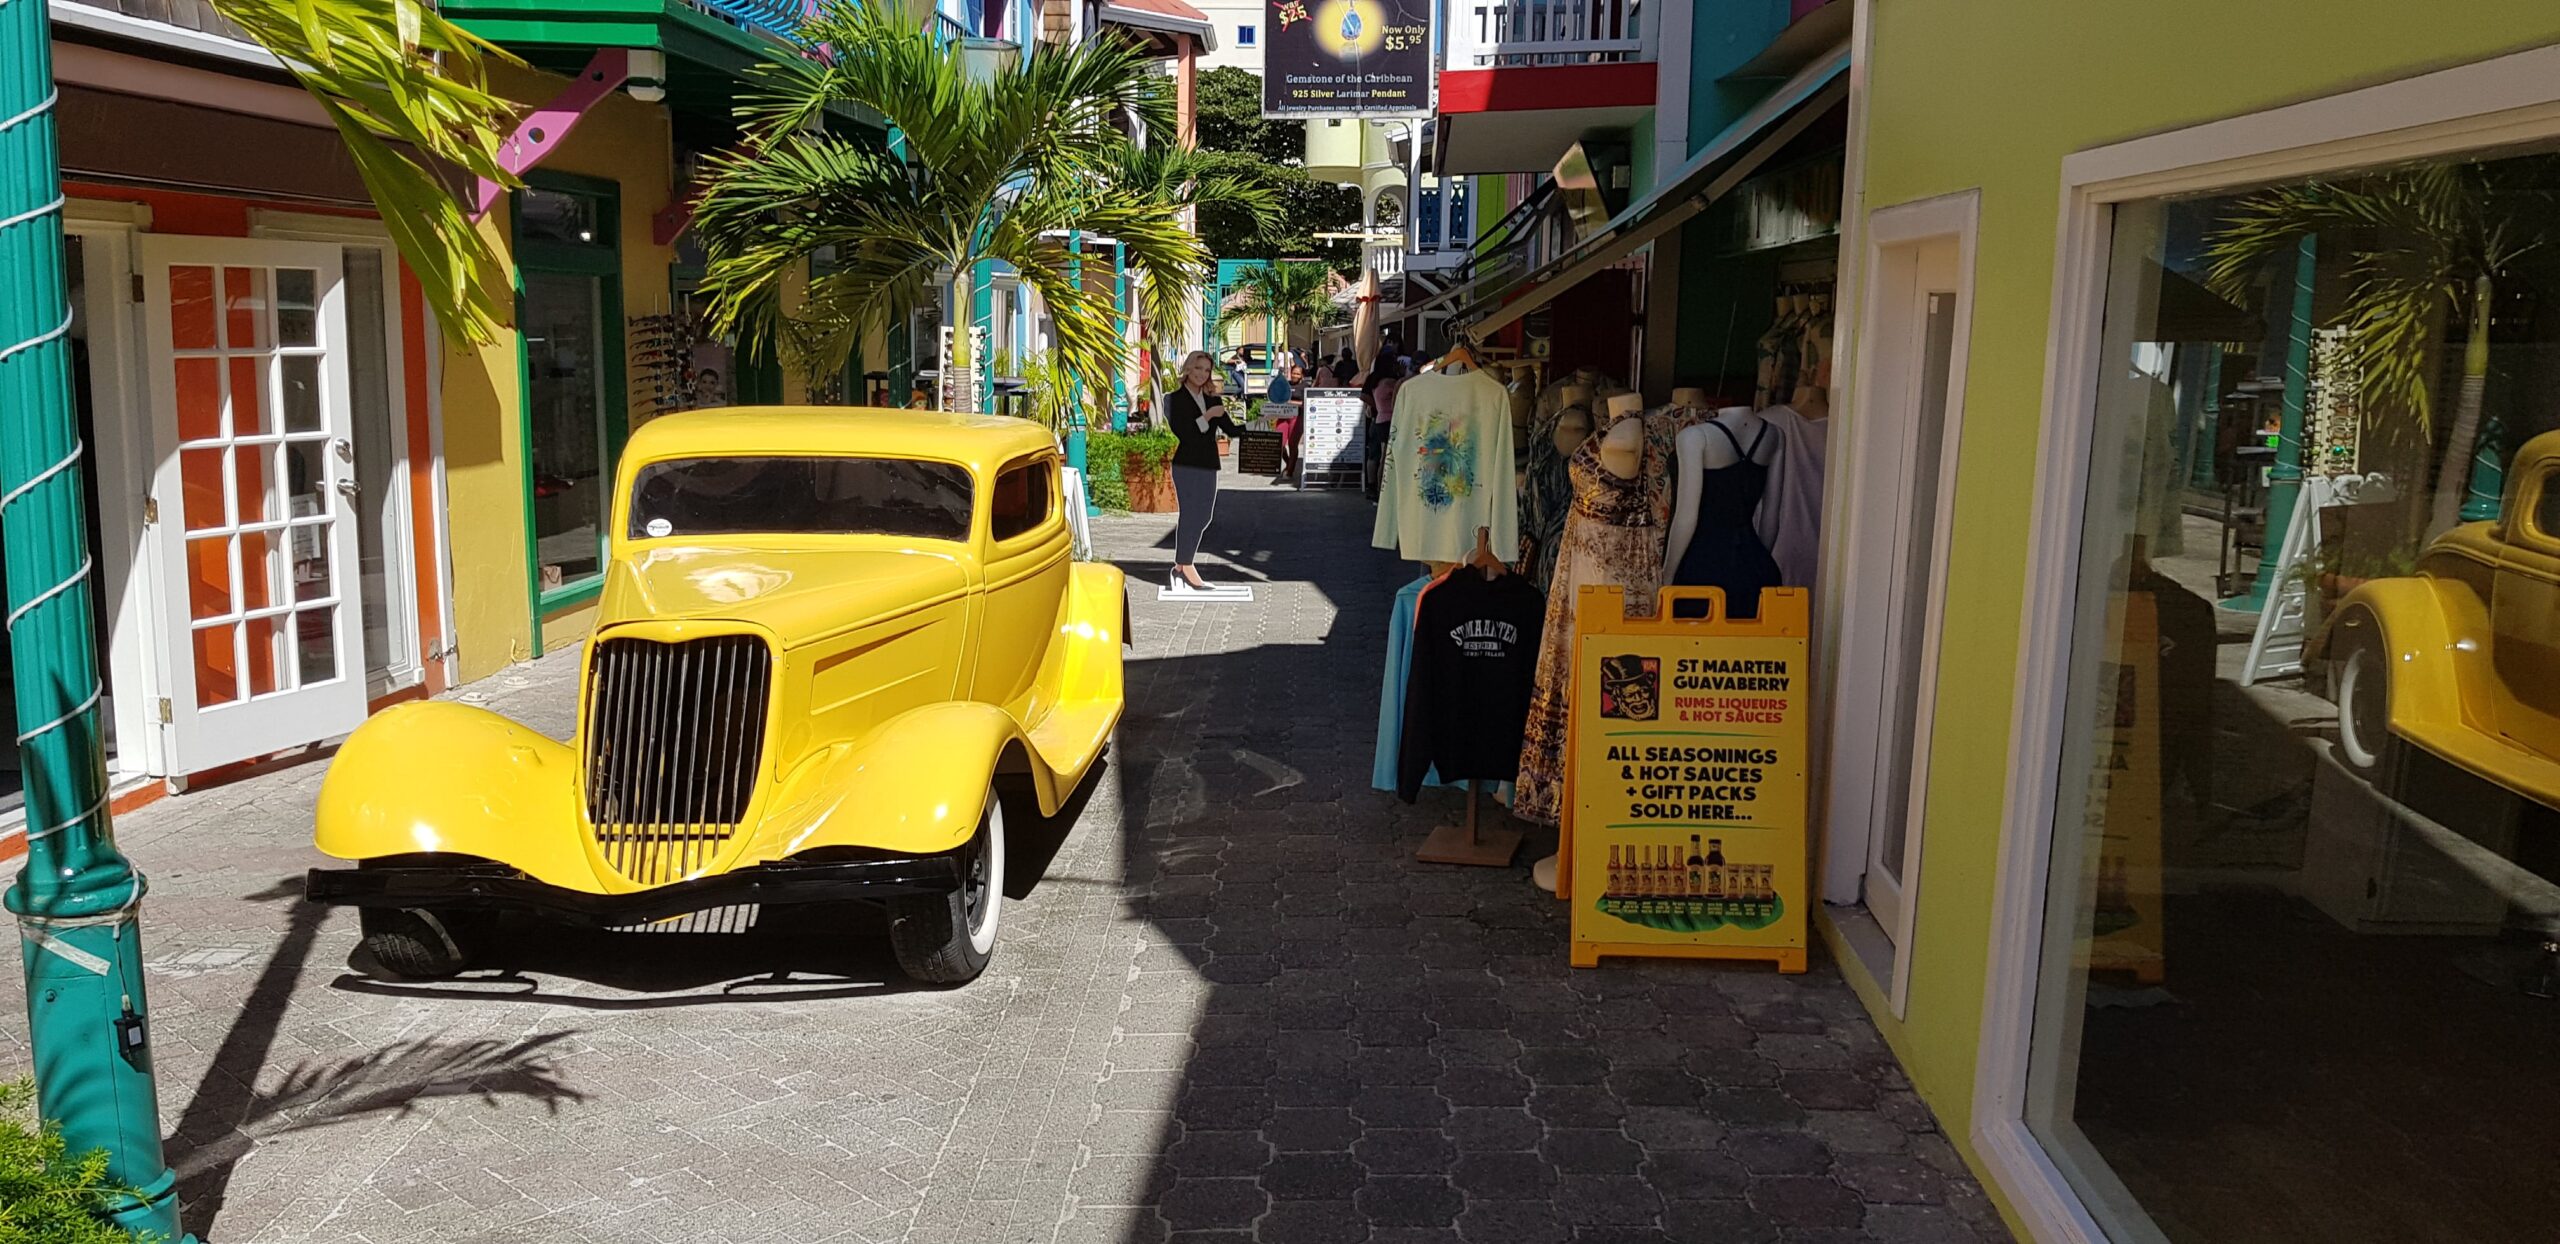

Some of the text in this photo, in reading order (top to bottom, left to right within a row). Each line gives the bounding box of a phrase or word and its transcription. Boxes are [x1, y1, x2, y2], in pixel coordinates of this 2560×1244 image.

[1279, 5, 1307, 25] $25
[1381, 24, 1426, 36] Now Only
[1286, 74, 1413, 83] Gemstone of the Caribbean
[1292, 89, 1407, 98] 925 Silver Larimar Pendant
[1677, 659, 1787, 674] ST MAARTEN
[1673, 675, 1790, 692] GUAVABERRY
[1675, 697, 1788, 712] RUMS LIQUEURS
[1679, 711, 1783, 724] & HOT SAUCES
[1607, 746, 1778, 764] ALL SEASONINGS
[1621, 765, 1763, 783] & HOT SAUCES
[1642, 784, 1685, 800] GIFT
[1689, 786, 1757, 802] PACKS
[1630, 803, 1753, 820] SOLD HERE...
